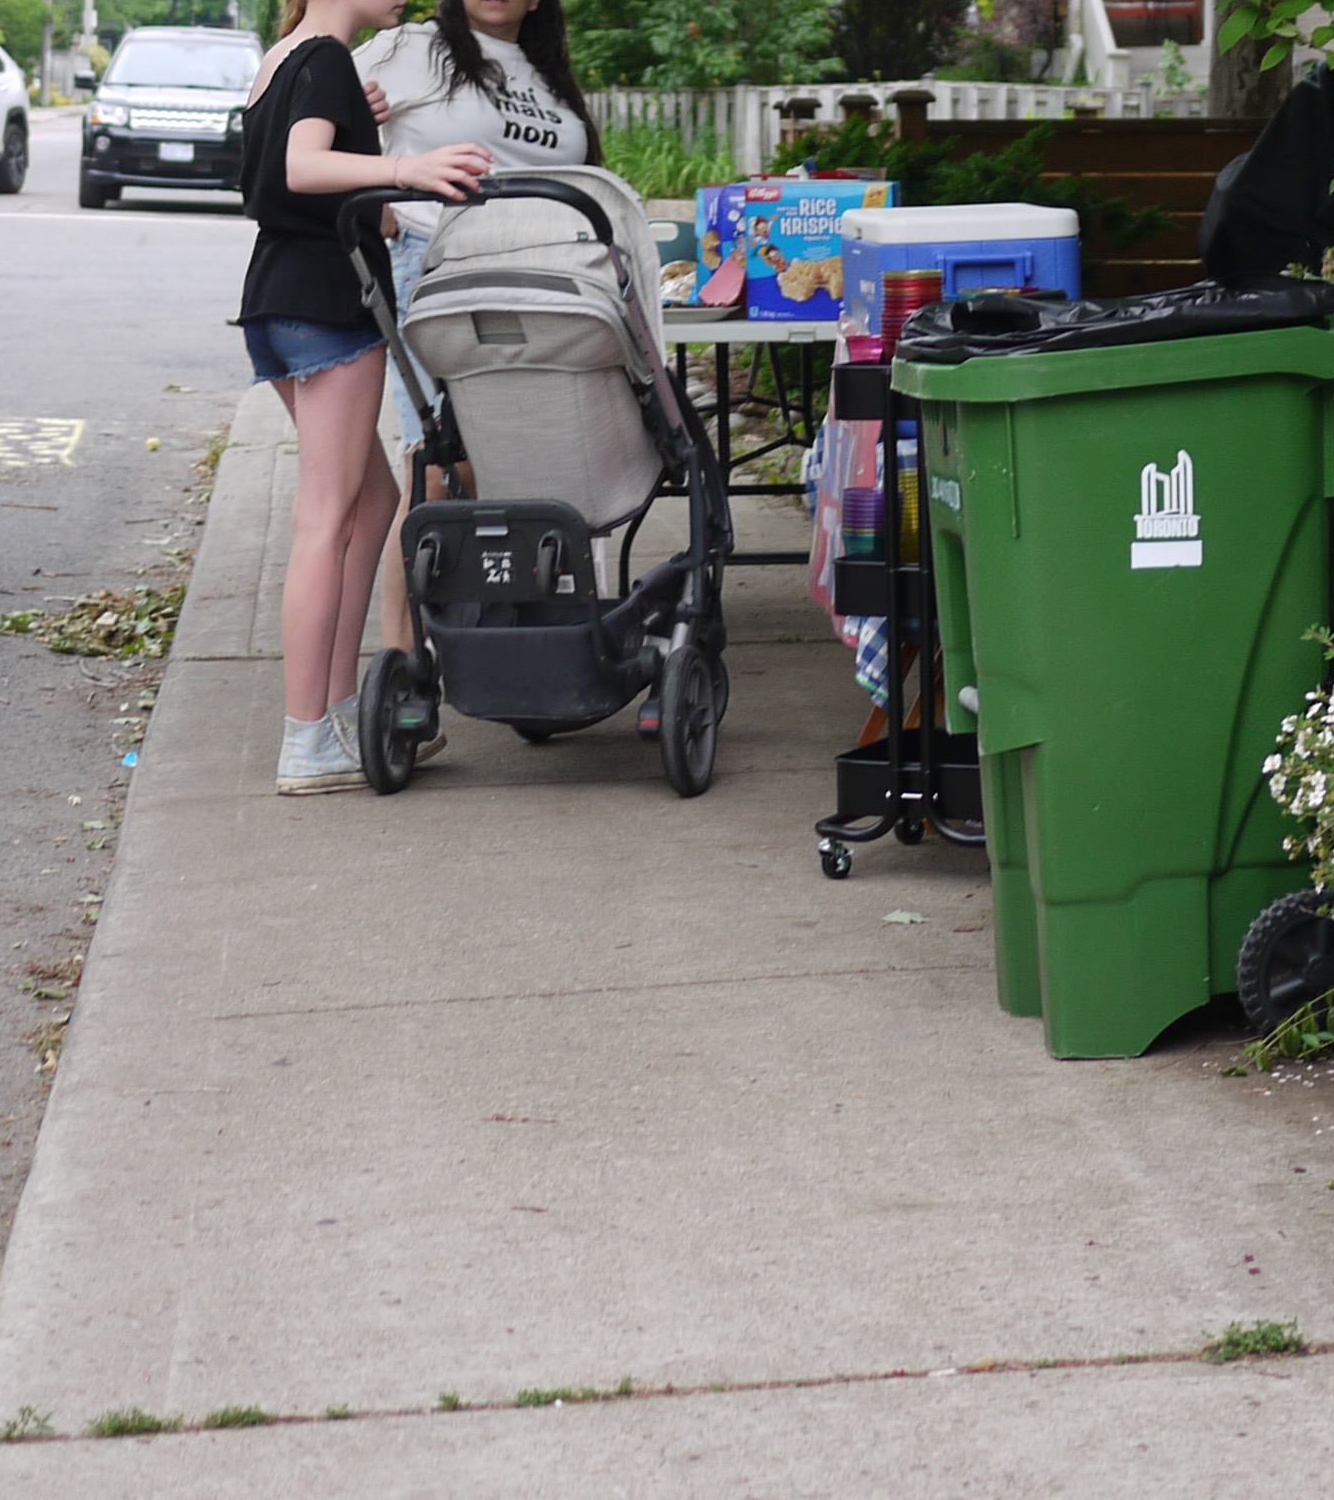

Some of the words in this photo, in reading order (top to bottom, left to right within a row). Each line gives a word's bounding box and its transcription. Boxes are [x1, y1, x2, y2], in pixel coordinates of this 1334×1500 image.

[496, 99, 562, 124] mais
[503, 120, 558, 149] non
[1134, 515, 1201, 538] TORONTO
